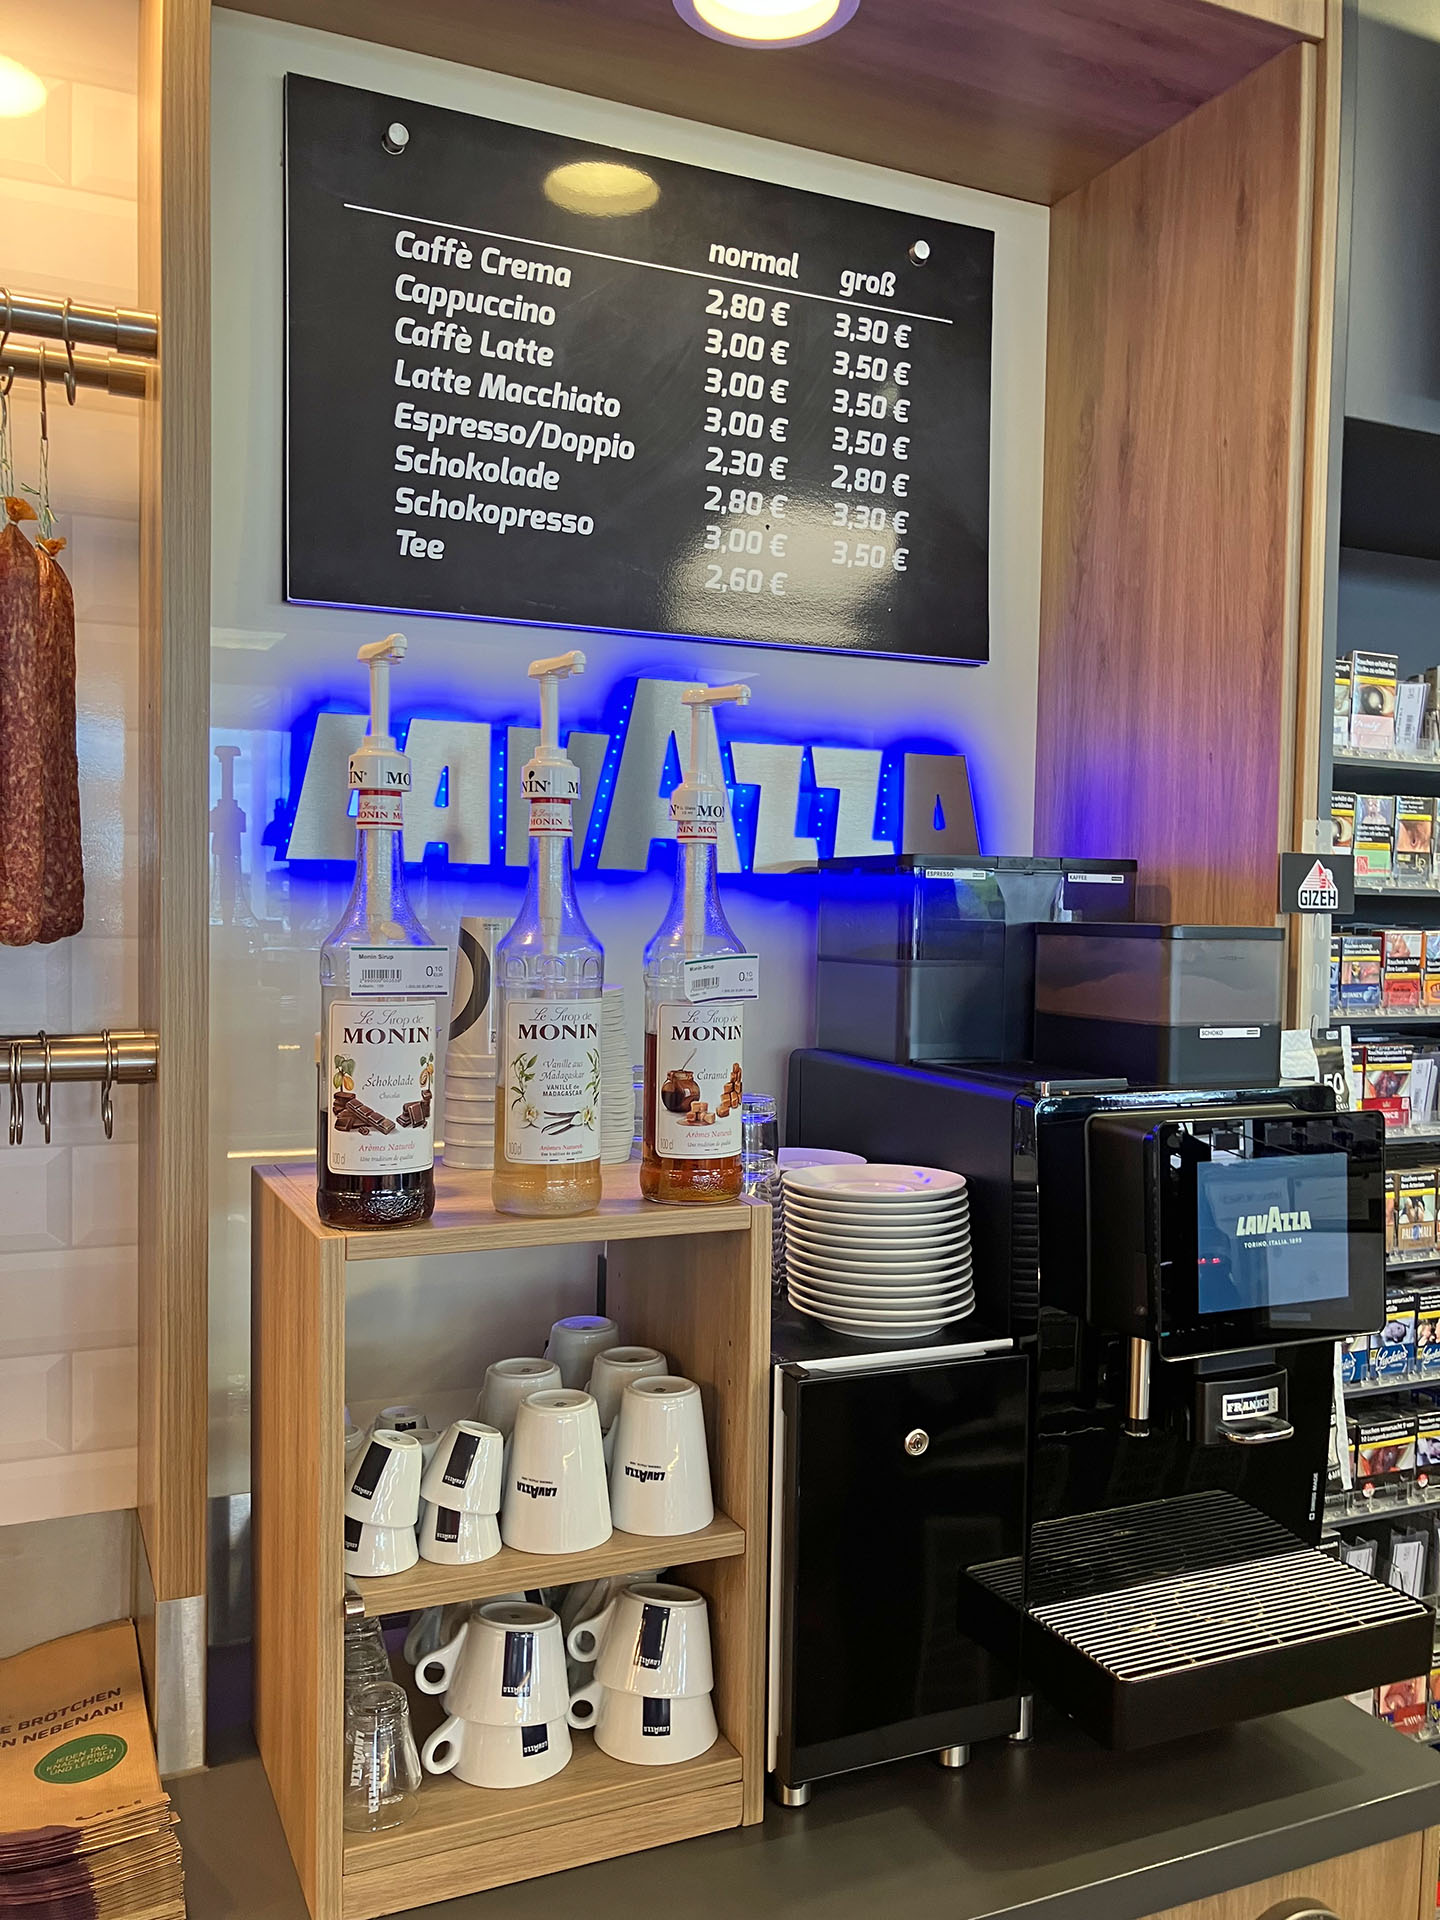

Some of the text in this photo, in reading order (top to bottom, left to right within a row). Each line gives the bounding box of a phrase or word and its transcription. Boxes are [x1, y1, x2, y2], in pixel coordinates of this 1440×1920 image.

[395, 231, 572, 288] Caffè Crema
[707, 243, 799, 279] normal
[395, 273, 556, 326] Cappuccino
[838, 270, 896, 297] groß
[705, 288, 790, 327] 2,80 €
[395, 317, 554, 367] Caffè Latte
[704, 328, 790, 365] 3,00 €
[833, 313, 912, 349] 3,30 €
[832, 350, 911, 386] 3,50 €
[394, 359, 621, 418] Latte Macchiato
[704, 368, 789, 404] 3,00 €
[832, 388, 911, 423] 3,50 €
[394, 402, 636, 464] Espresso/Doppio
[704, 406, 789, 442] 3,00 €
[831, 426, 910, 460] 3,50 €
[394, 444, 560, 491] Schokolade
[705, 446, 788, 481] 2,30 €
[831, 464, 910, 497] 2,80 €
[394, 487, 594, 535] Schokopresso
[704, 485, 788, 519] 2,80 €
[832, 502, 910, 534] 3,30 €
[396, 529, 445, 560] Tee
[704, 525, 788, 557] 3,00 €
[831, 540, 910, 571] 3,50 €
[704, 564, 788, 595] 2,60 €
[285, 679, 982, 873] LAVAZZA
[1300, 890, 1336, 906] GIZEH
[354, 1009, 373, 1025] Le
[377, 1009, 410, 1028] Sirop
[529, 1006, 547, 1021] Le
[550, 1006, 580, 1024] Sirop
[682, 1010, 699, 1024] Le
[343, 1026, 431, 1045] MONIN
[518, 1023, 597, 1041] MONIN
[362, 1073, 414, 1090] Schokolade
[539, 1071, 585, 1083] Madagaskar
[696, 1068, 728, 1080] Caramel
[358, 1143, 386, 1152] Arômes
[1236, 1206, 1312, 1236] LAVAZZA
[1227, 1398, 1269, 1413] FRANKE
[517, 1481, 557, 1498] LAVAZZA
[625, 1465, 665, 1483] LAVAZZA
[18, 1687, 121, 1731] BRÖTCHEN
[643, 1726, 670, 1735] LAVAZZA
[46, 1747, 117, 1772] KNACKERISCH
[50, 1753, 114, 1776] UND LECKER
[56, 1744, 109, 1764] JEDEN TAG
